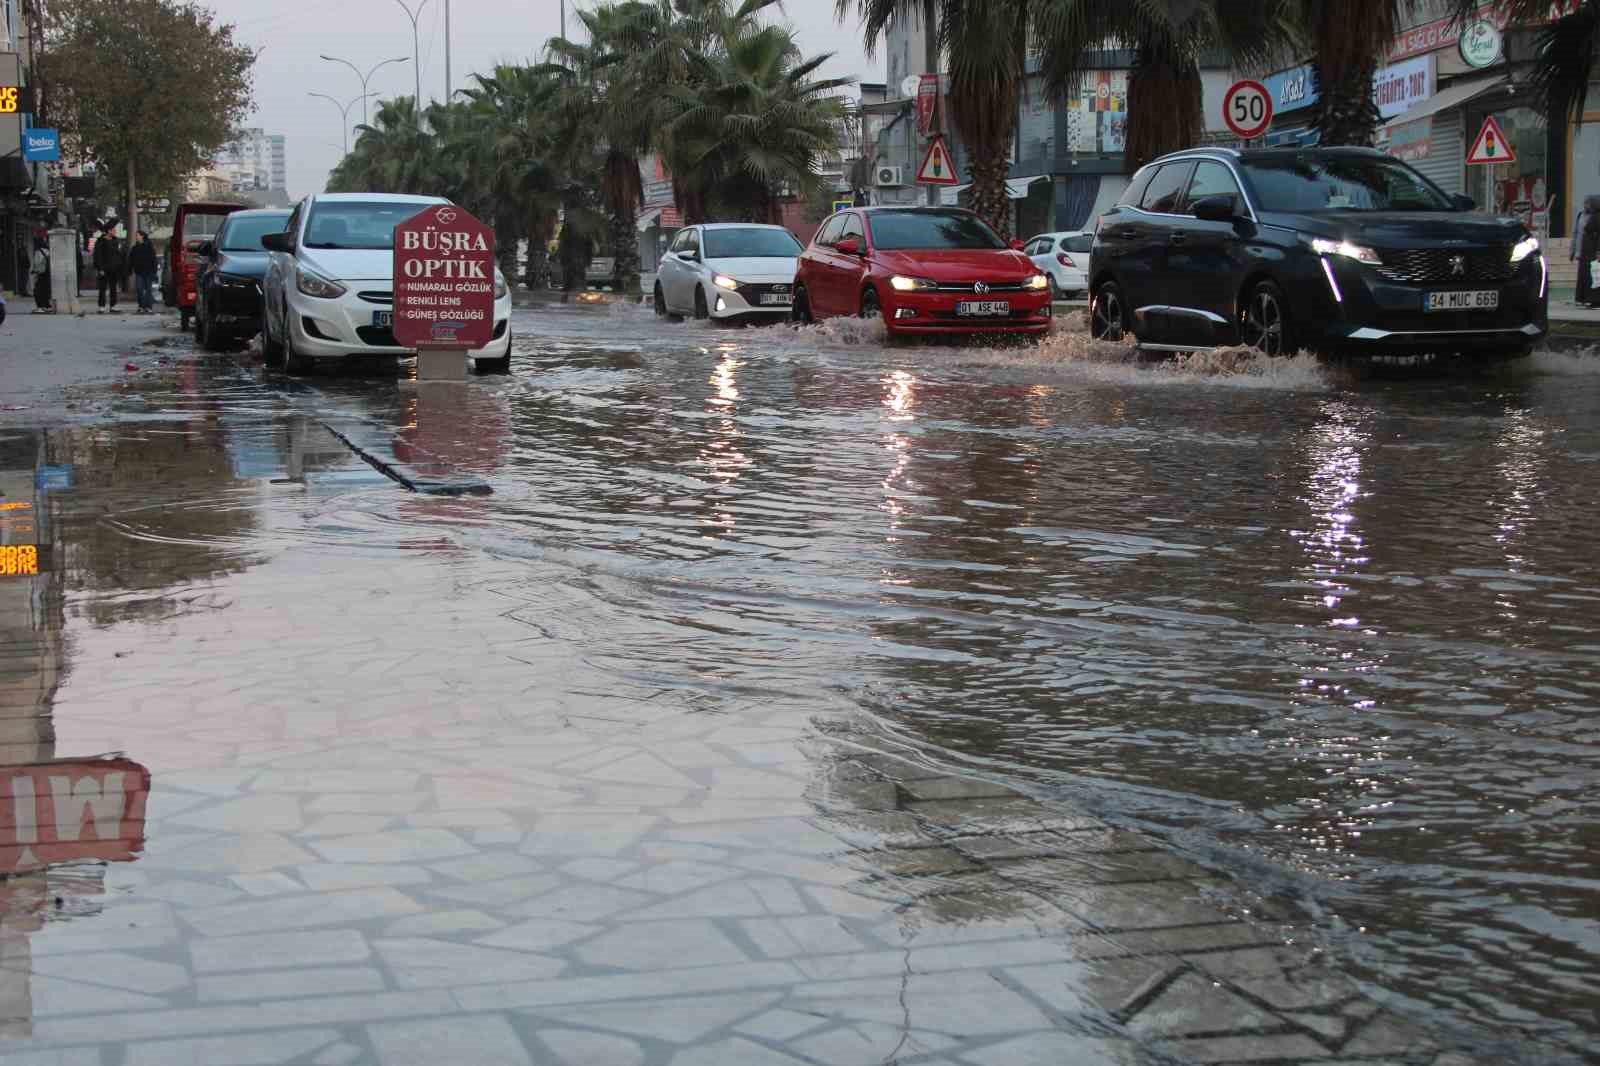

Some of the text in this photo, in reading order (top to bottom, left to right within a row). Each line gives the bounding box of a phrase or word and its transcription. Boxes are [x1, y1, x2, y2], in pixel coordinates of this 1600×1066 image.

[1235, 95, 1263, 121] 50
[29, 136, 55, 146] beko
[403, 226, 488, 256] BÜŞRA
[404, 254, 487, 279] OPTİK
[407, 281, 492, 293] NUMARALI GÖZLÜK
[407, 296, 462, 306] RENKLİ LENS
[1431, 293, 1444, 307] 34
[961, 302, 972, 313] 01
[407, 308, 484, 321] GÜNEŞ GÖZLÜĞÜ
